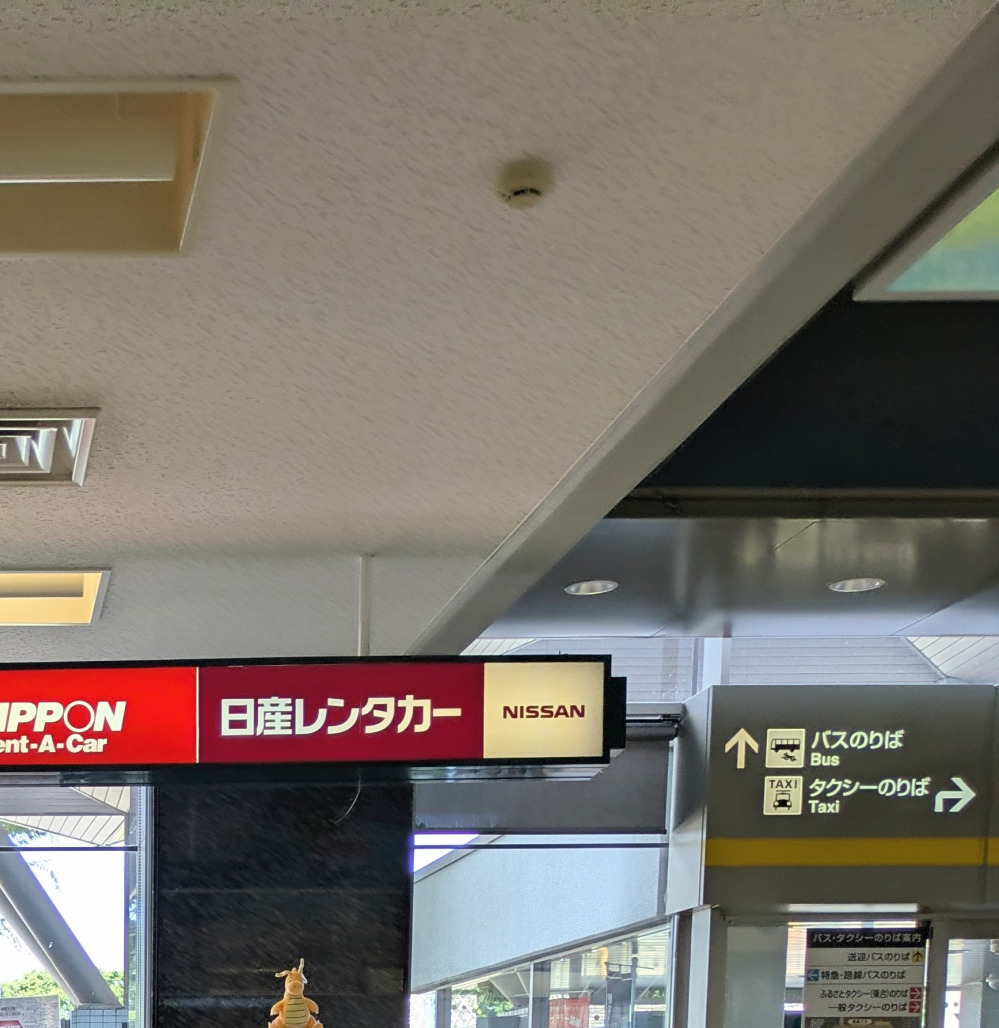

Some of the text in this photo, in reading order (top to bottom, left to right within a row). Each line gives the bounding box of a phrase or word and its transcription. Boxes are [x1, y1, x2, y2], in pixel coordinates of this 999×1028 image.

[220, 695, 462, 736] 日産レンタカー
[502, 704, 586, 718] NISSAN
[811, 730, 905, 749] バスのりば
[810, 753, 840, 767] Bus
[769, 780, 798, 789] TAXI
[808, 777, 931, 797] タクシーのりば
[808, 800, 840, 814] Taxi
[813, 931, 922, 943] バス・タクシーのりば案内
[847, 951, 910, 962] 送迎バスのりば
[821, 969, 906, 980] 特急・路線バスのりば
[828, 1002, 908, 1013] 一般タクシーのりば
